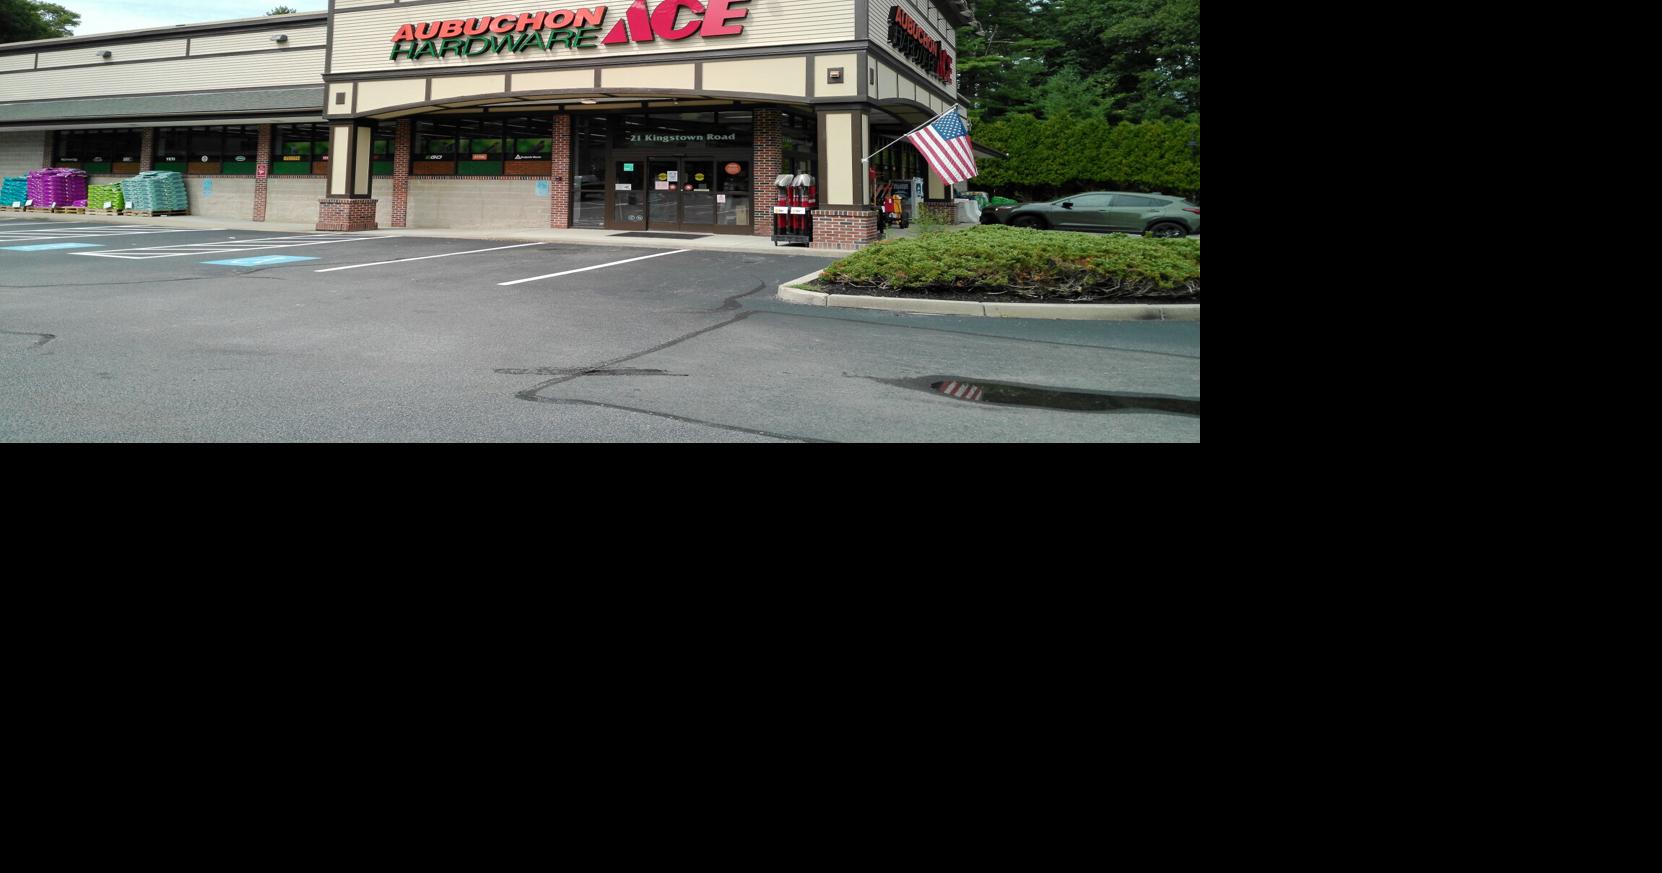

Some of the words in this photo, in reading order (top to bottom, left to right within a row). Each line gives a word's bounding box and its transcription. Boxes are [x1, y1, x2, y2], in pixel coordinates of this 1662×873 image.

[391, 6, 608, 42] AUBUCHON
[601, 0, 749, 45] ACE
[389, 28, 603, 61] HARDWARE
[630, 134, 641, 142] 21
[644, 133, 704, 143] Kingstown
[706, 133, 736, 141] Road
